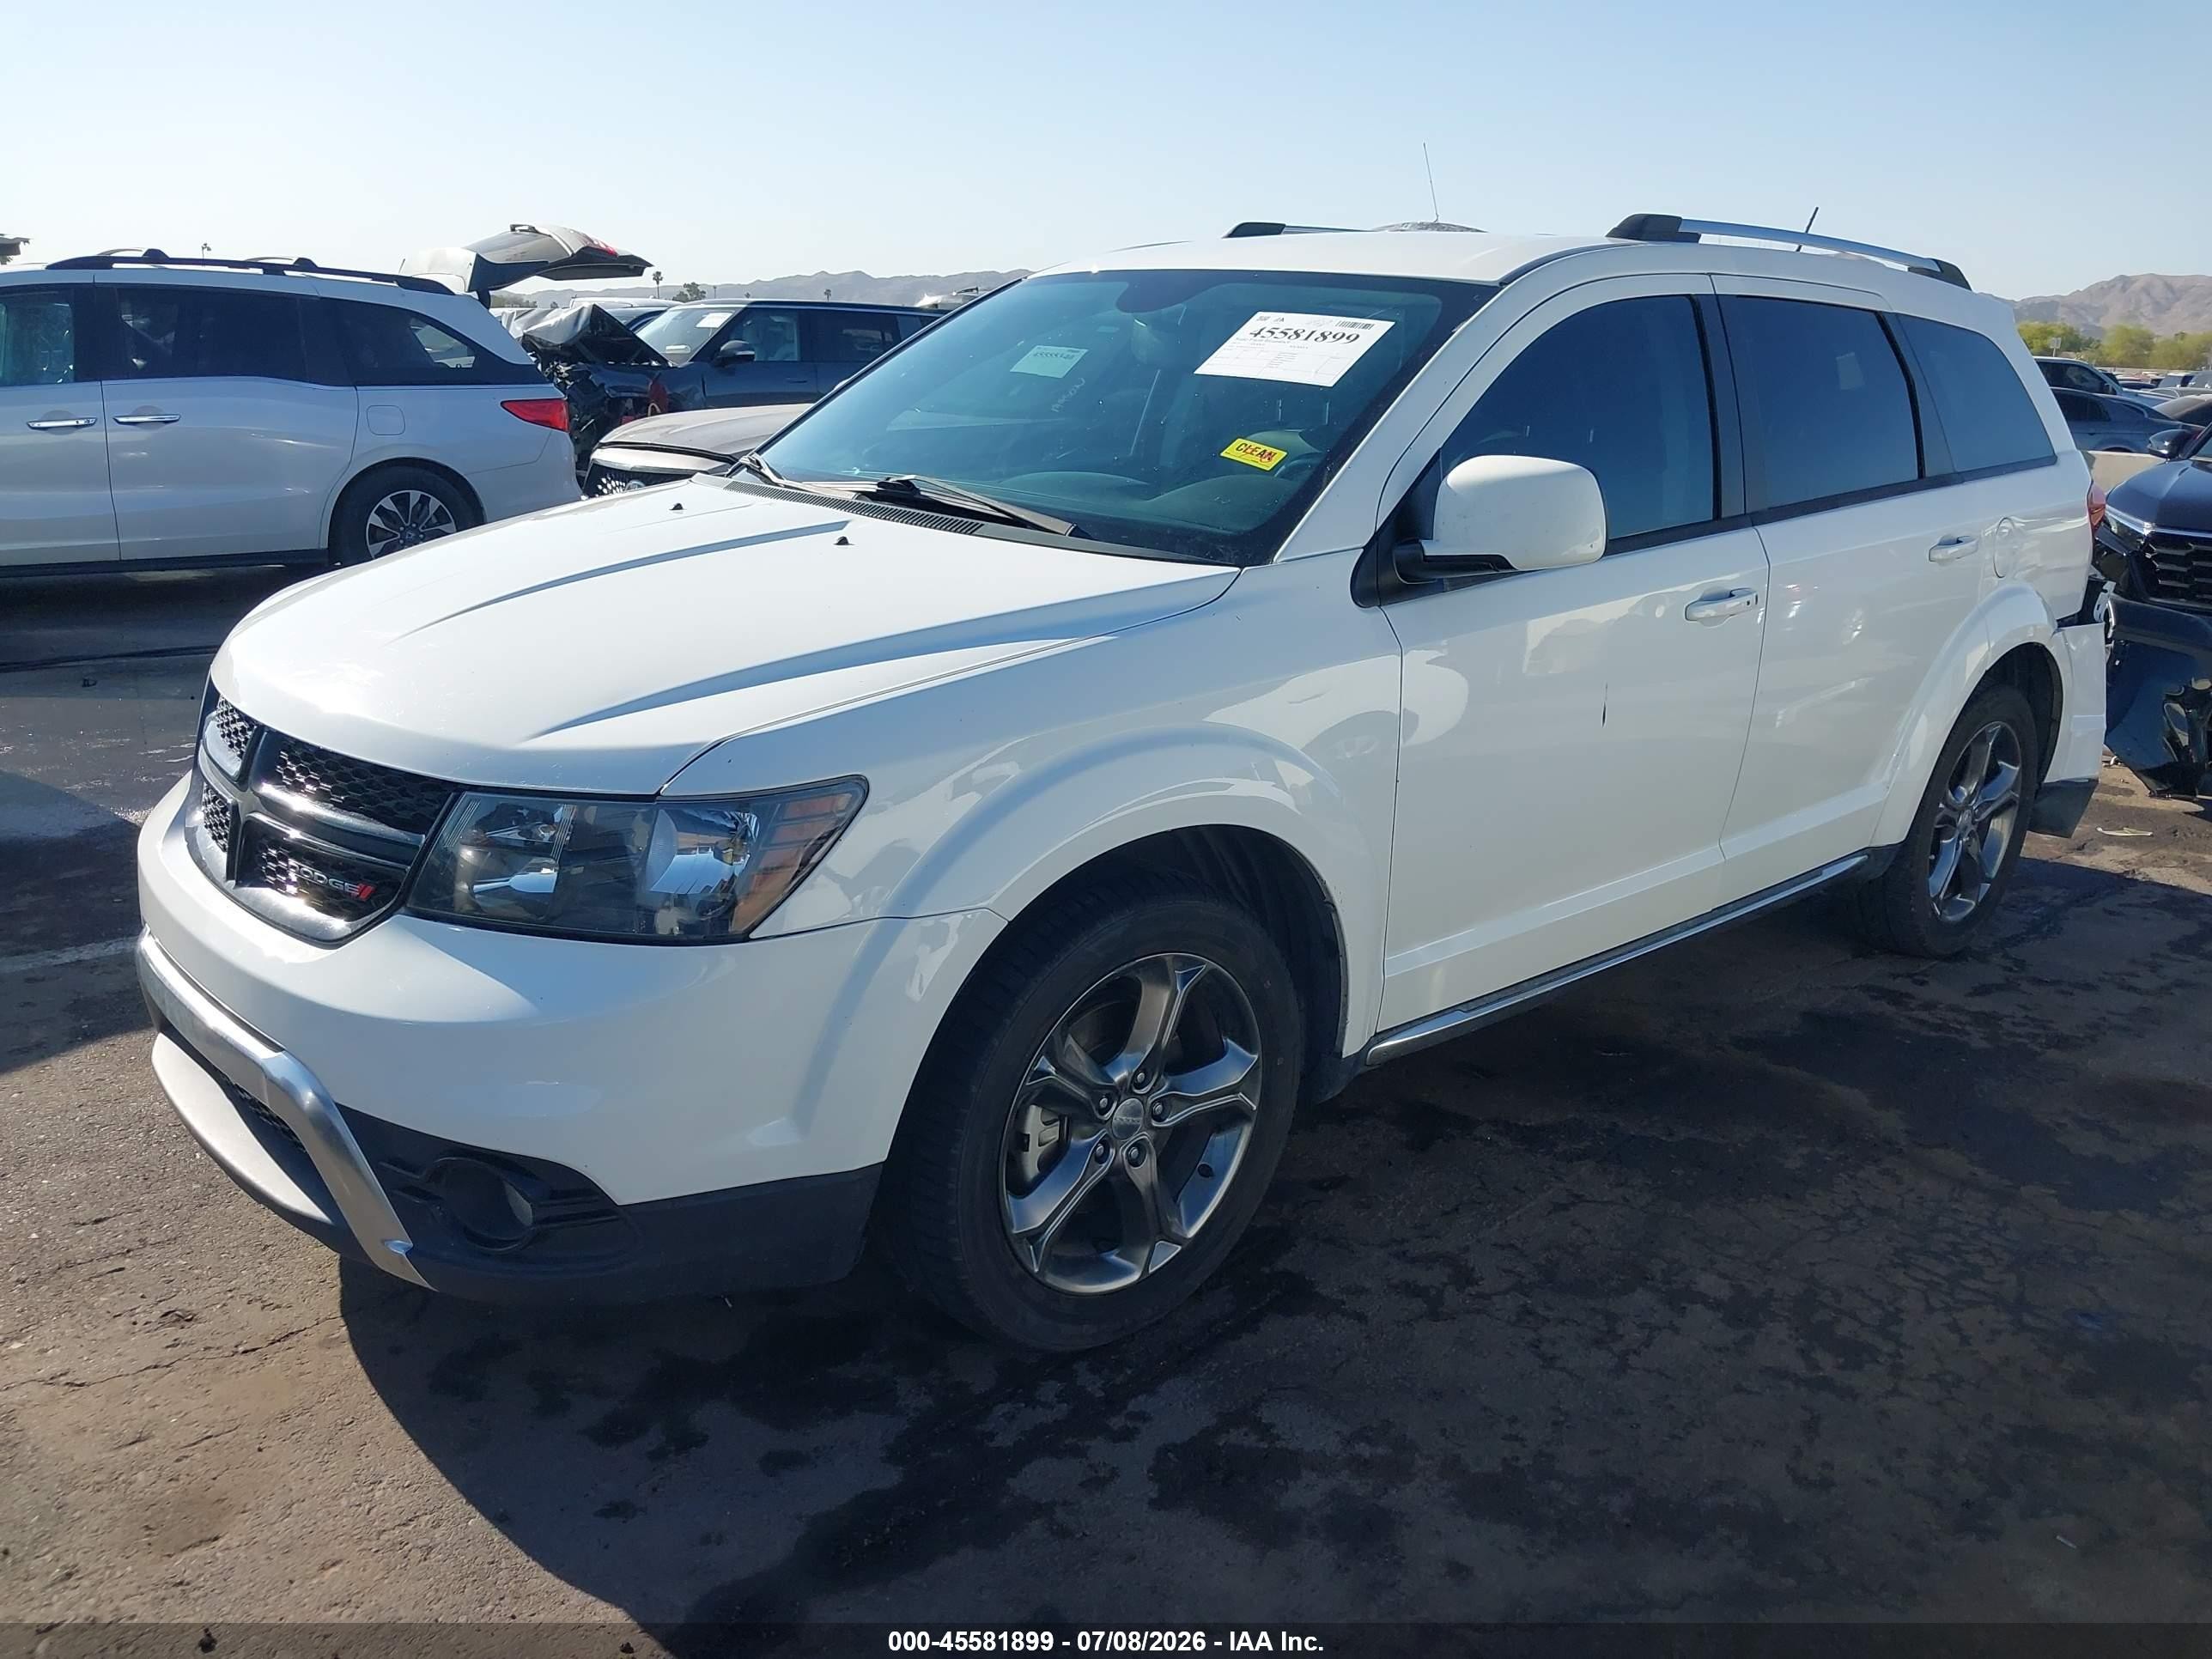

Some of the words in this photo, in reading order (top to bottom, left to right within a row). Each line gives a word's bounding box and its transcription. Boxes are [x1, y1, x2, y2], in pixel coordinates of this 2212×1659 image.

[1249, 325, 1360, 344] 45581899
[1236, 442, 1277, 461] CLEAN
[289, 861, 360, 895] DODGE
